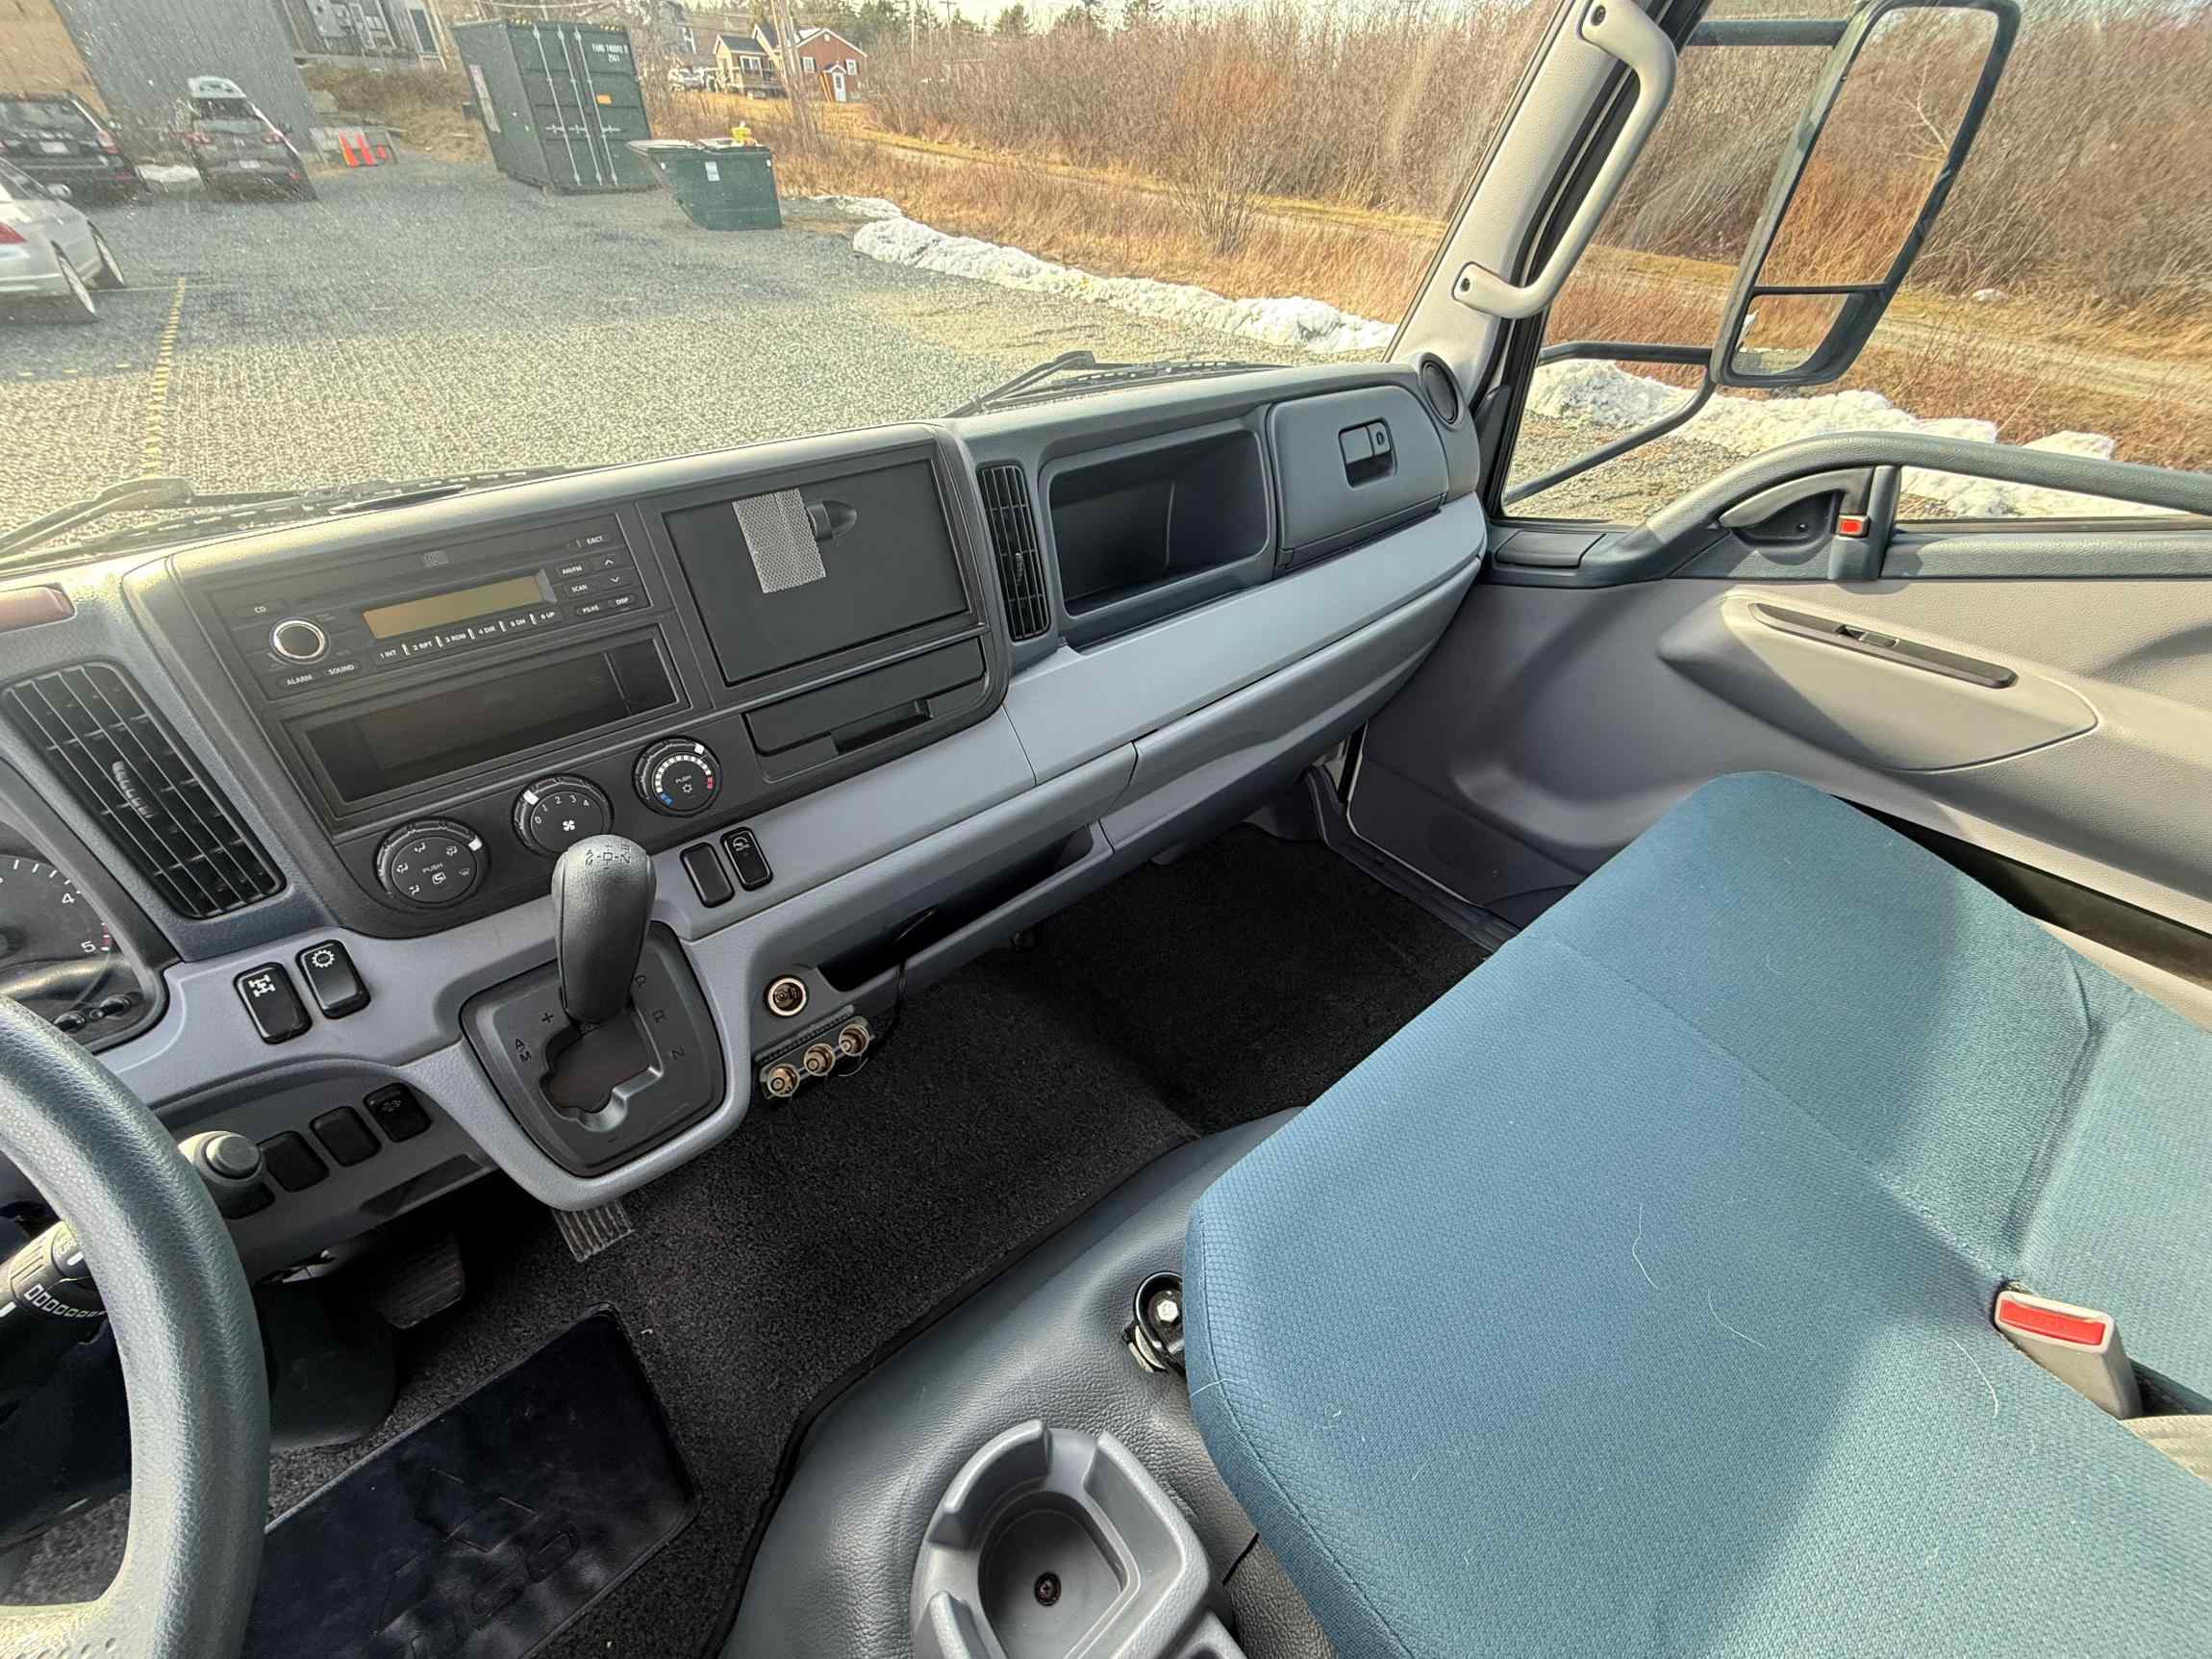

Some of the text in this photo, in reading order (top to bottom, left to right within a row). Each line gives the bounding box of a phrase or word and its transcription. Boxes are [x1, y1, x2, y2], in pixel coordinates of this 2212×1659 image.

[571, 584, 588, 593] SCAN
[328, 664, 355, 675] SOUND
[287, 674, 313, 686] ALARM
[534, 816, 542, 824] 0
[541, 803, 548, 812] 1
[554, 795, 563, 804] 2
[569, 794, 577, 803] 3
[61, 892, 75, 905] 4
[81, 940, 96, 953] 5
